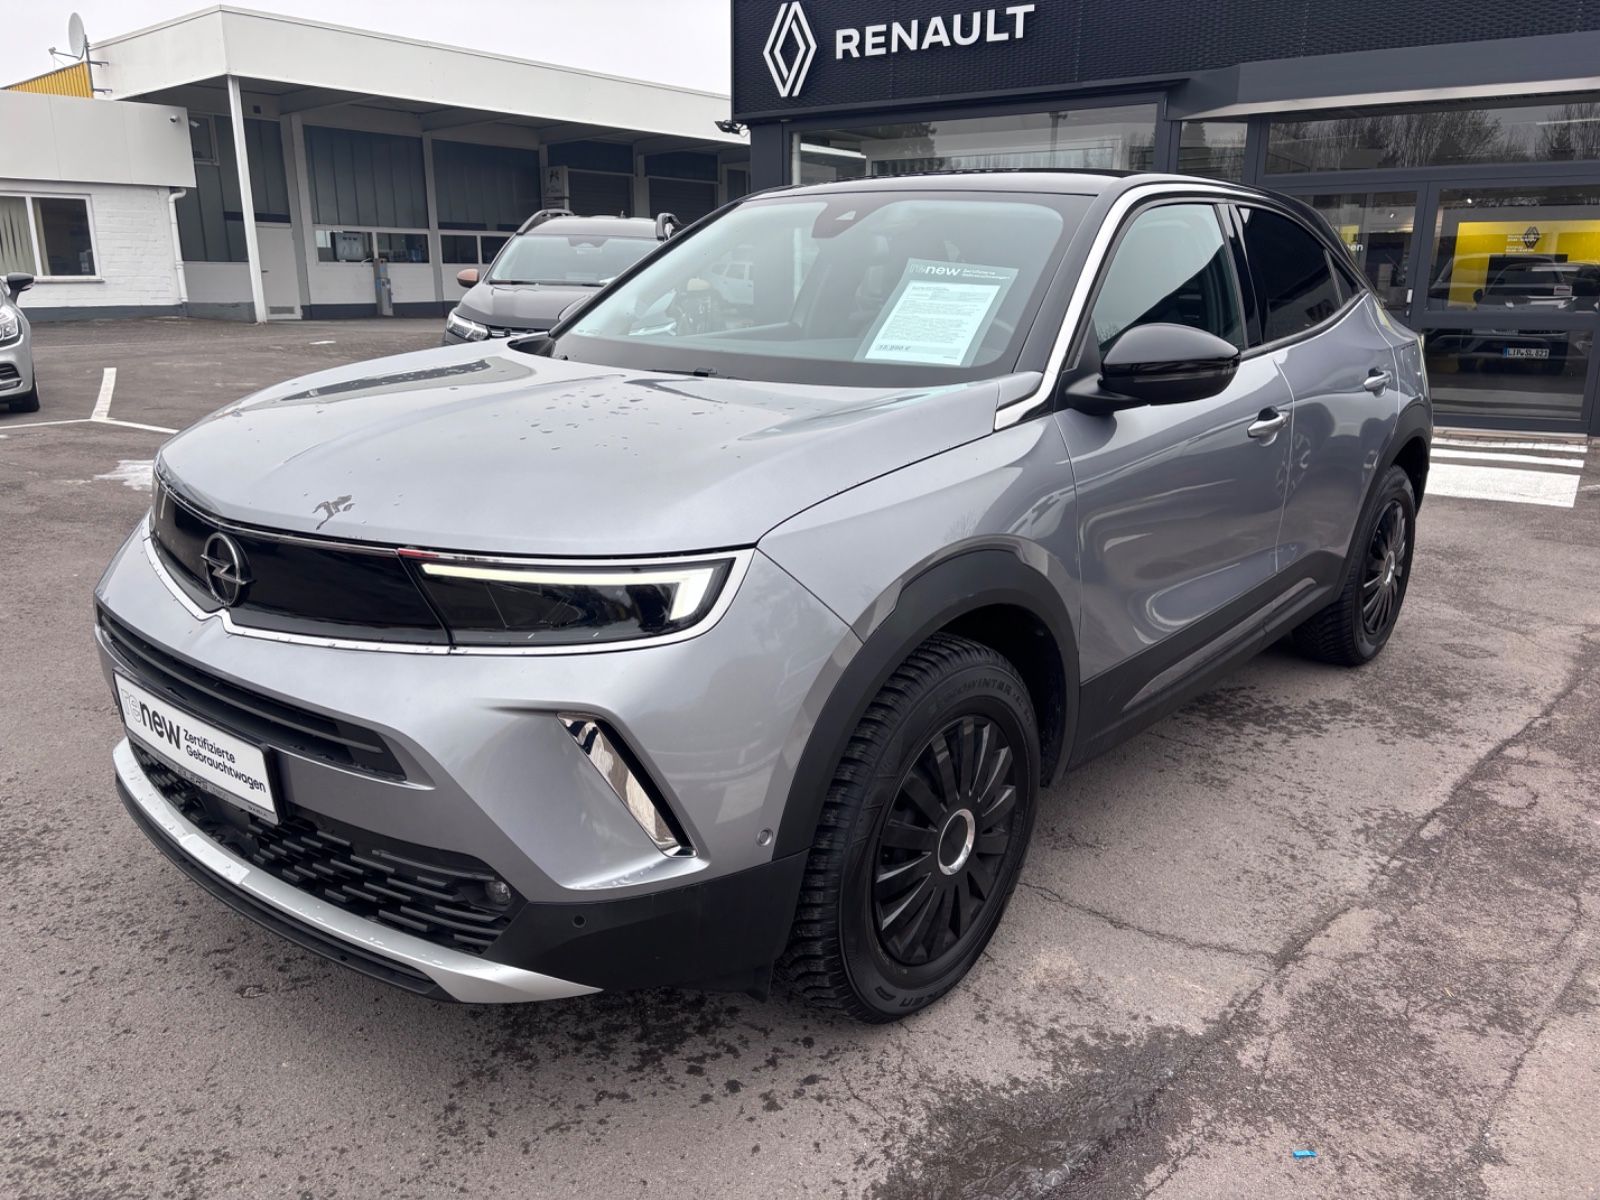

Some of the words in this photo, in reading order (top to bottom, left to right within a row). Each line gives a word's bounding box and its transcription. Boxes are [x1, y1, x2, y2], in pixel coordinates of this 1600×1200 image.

[835, 4, 1035, 60] RENAULT
[120, 687, 181, 750] renew
[183, 728, 236, 764] Zertifizierte
[186, 744, 267, 793] Gebrauchtwagen
